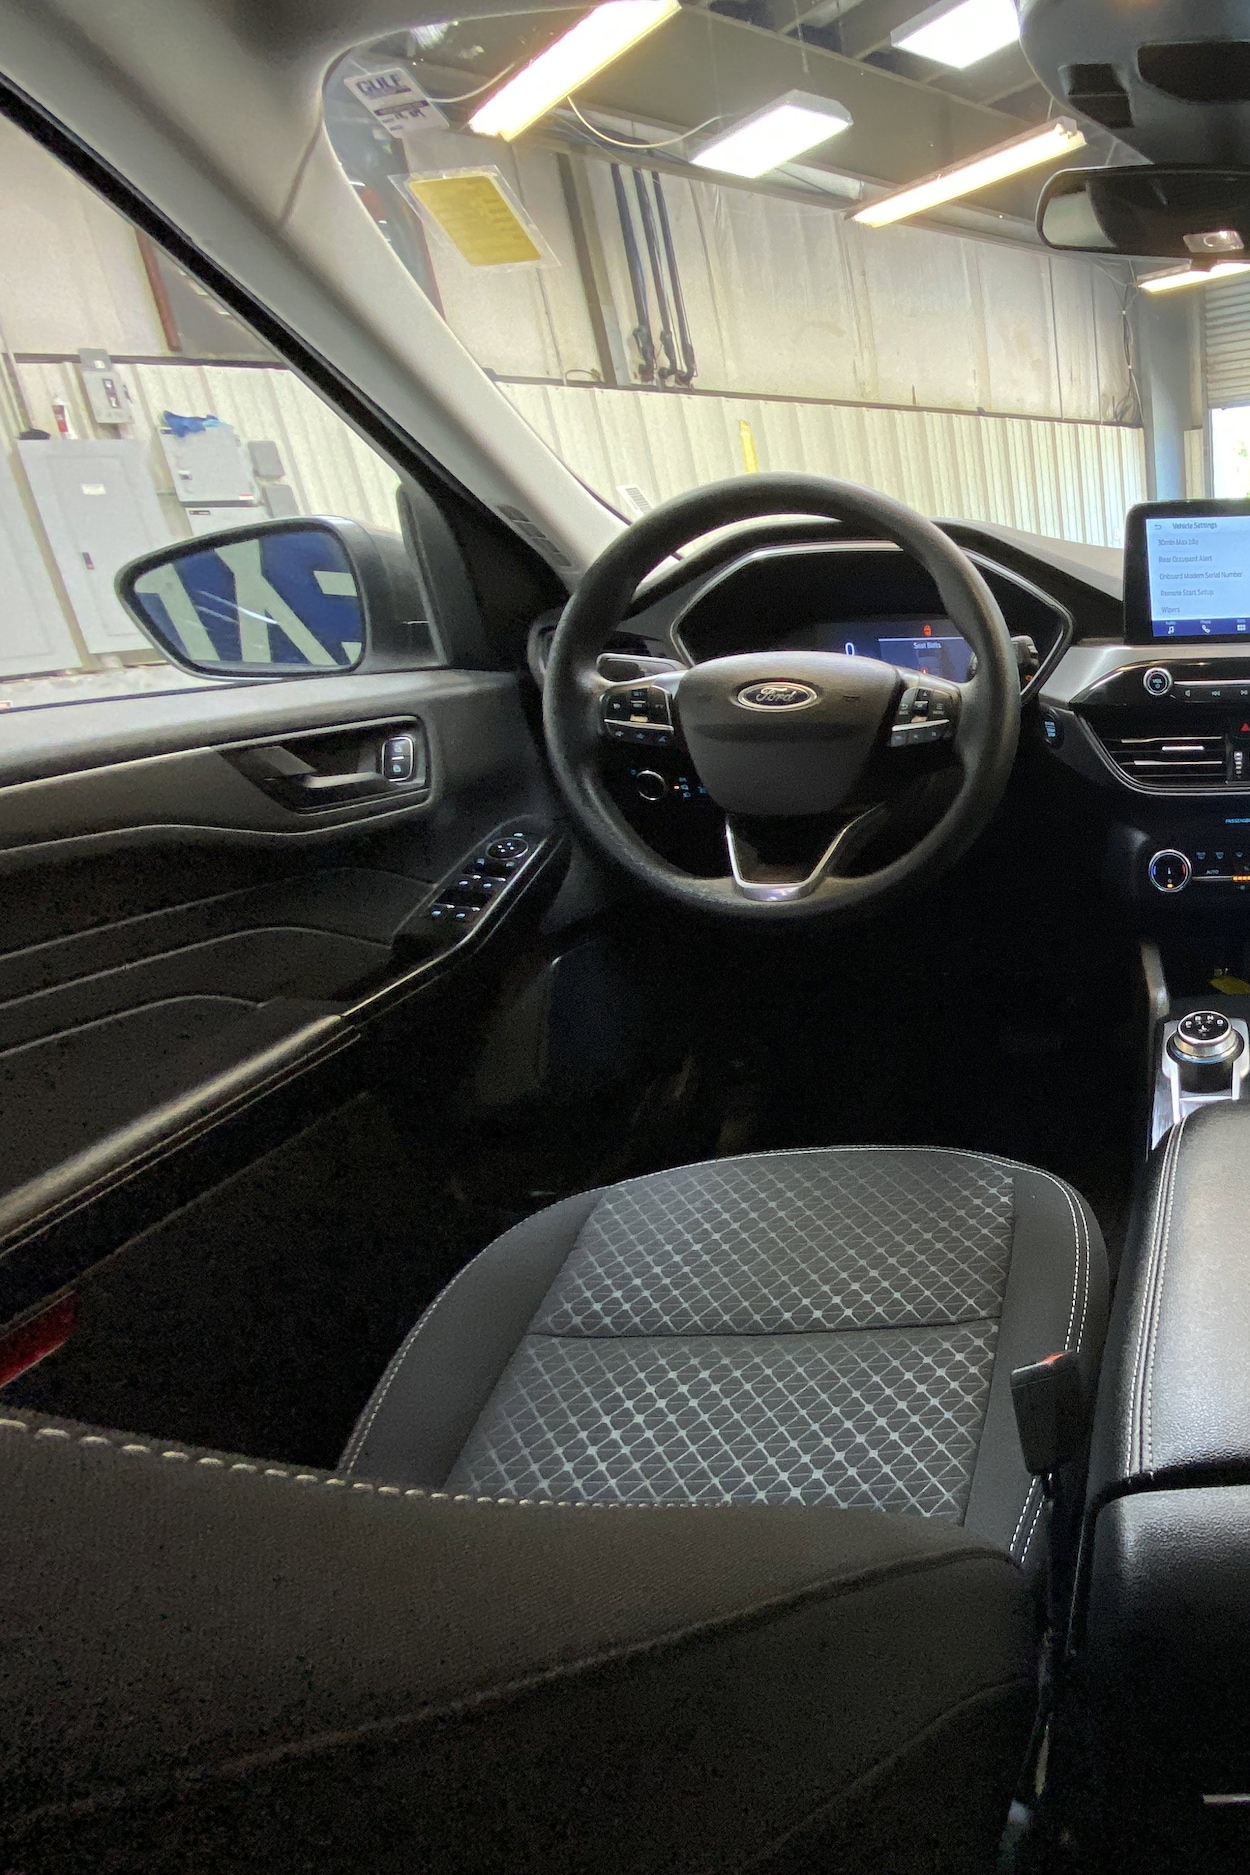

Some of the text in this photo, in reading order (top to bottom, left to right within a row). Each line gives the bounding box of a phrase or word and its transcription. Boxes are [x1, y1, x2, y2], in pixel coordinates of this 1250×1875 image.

[1172, 521, 1217, 530] Vehicle Settings
[756, 687, 797, 701] Ford
